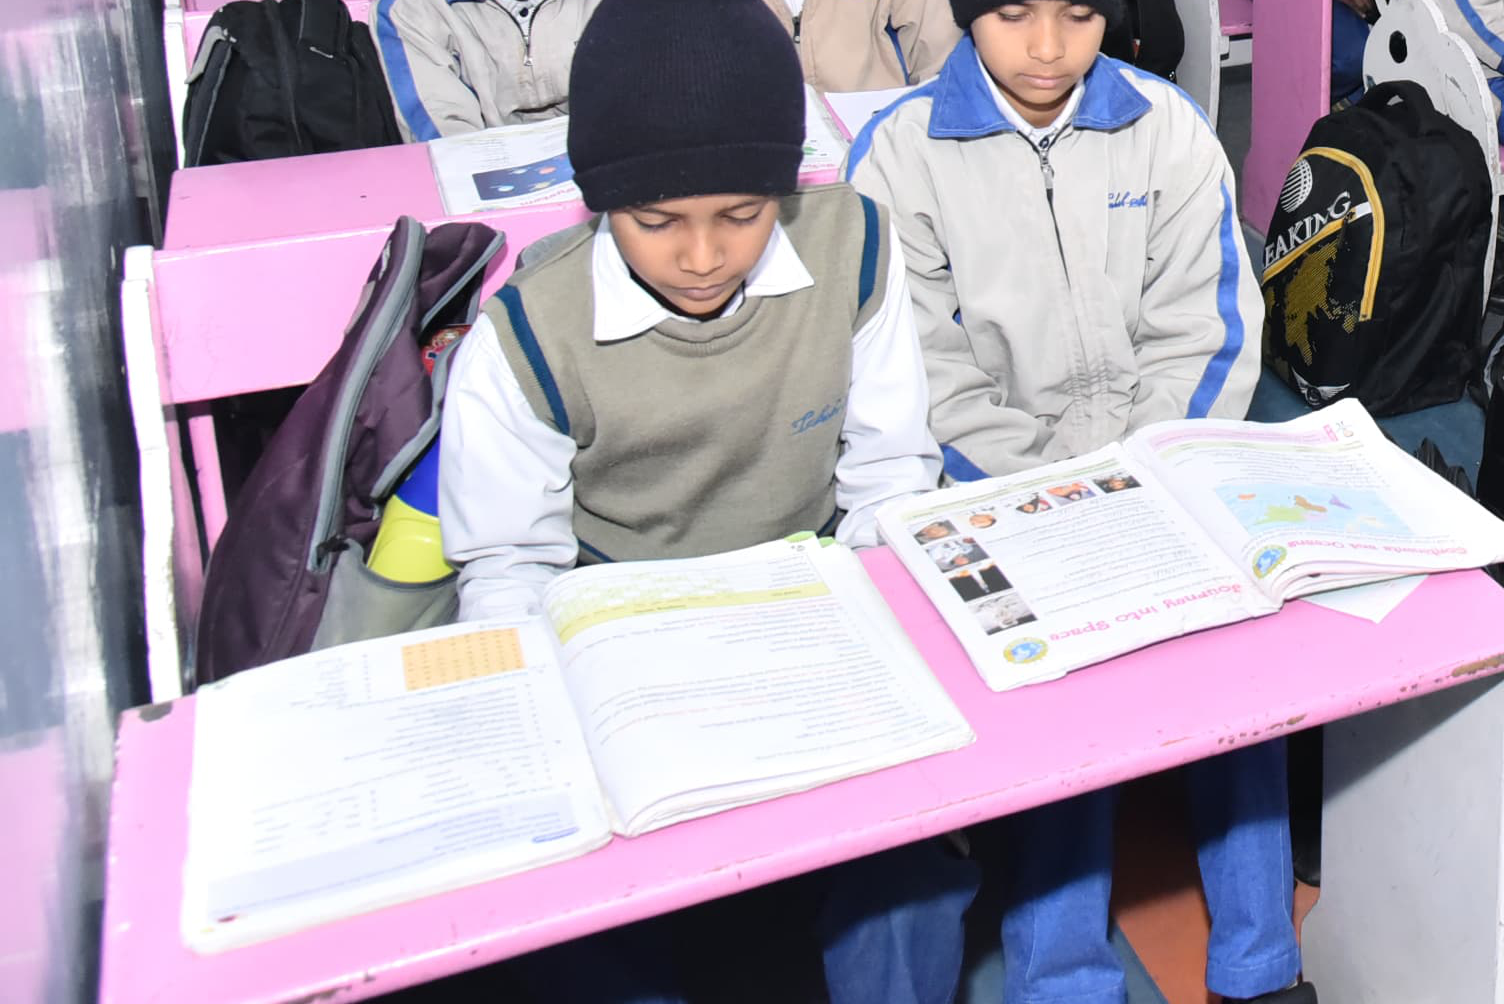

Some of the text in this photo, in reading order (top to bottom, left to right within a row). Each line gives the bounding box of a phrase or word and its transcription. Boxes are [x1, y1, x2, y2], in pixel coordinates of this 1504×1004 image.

[1050, 583, 1242, 641] Journey into Space
